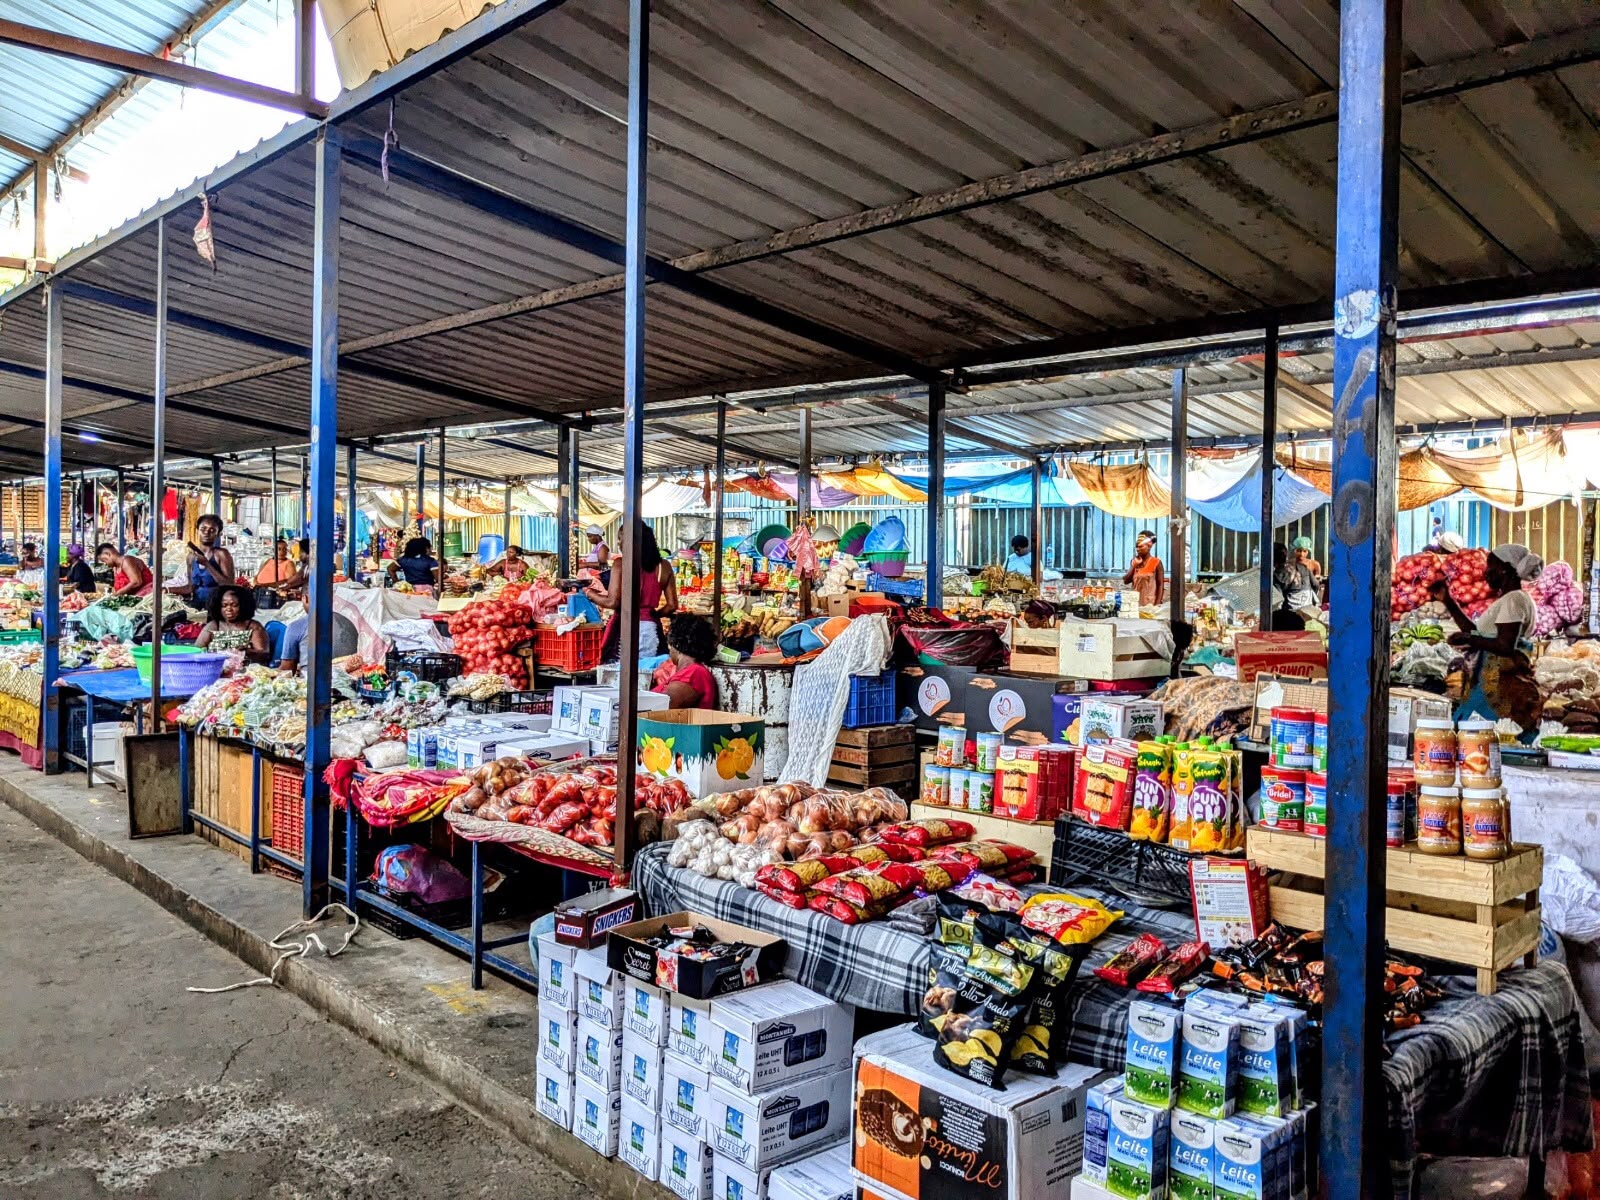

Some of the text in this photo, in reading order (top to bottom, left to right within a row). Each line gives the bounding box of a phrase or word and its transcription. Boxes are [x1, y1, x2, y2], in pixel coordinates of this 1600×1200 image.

[1193, 791, 1220, 806] PUN
[1269, 788, 1292, 799] Bridel
[594, 906, 633, 933] SNICKERS
[559, 924, 581, 936] SNICKERS
[624, 946, 652, 970] Secret
[940, 957, 960, 975] Pollo
[975, 970, 1013, 995] Artesanal
[977, 994, 1009, 1016] Asado
[771, 1048, 783, 1058] UHT
[1132, 1040, 1168, 1060] Leite
[1185, 1049, 1222, 1070] Leite
[757, 1070, 763, 1078] 12
[761, 1121, 788, 1136] Leite UHT
[1114, 1134, 1149, 1156] Leite
[1175, 1145, 1209, 1167] Leite
[1220, 1162, 1257, 1183] Leite
